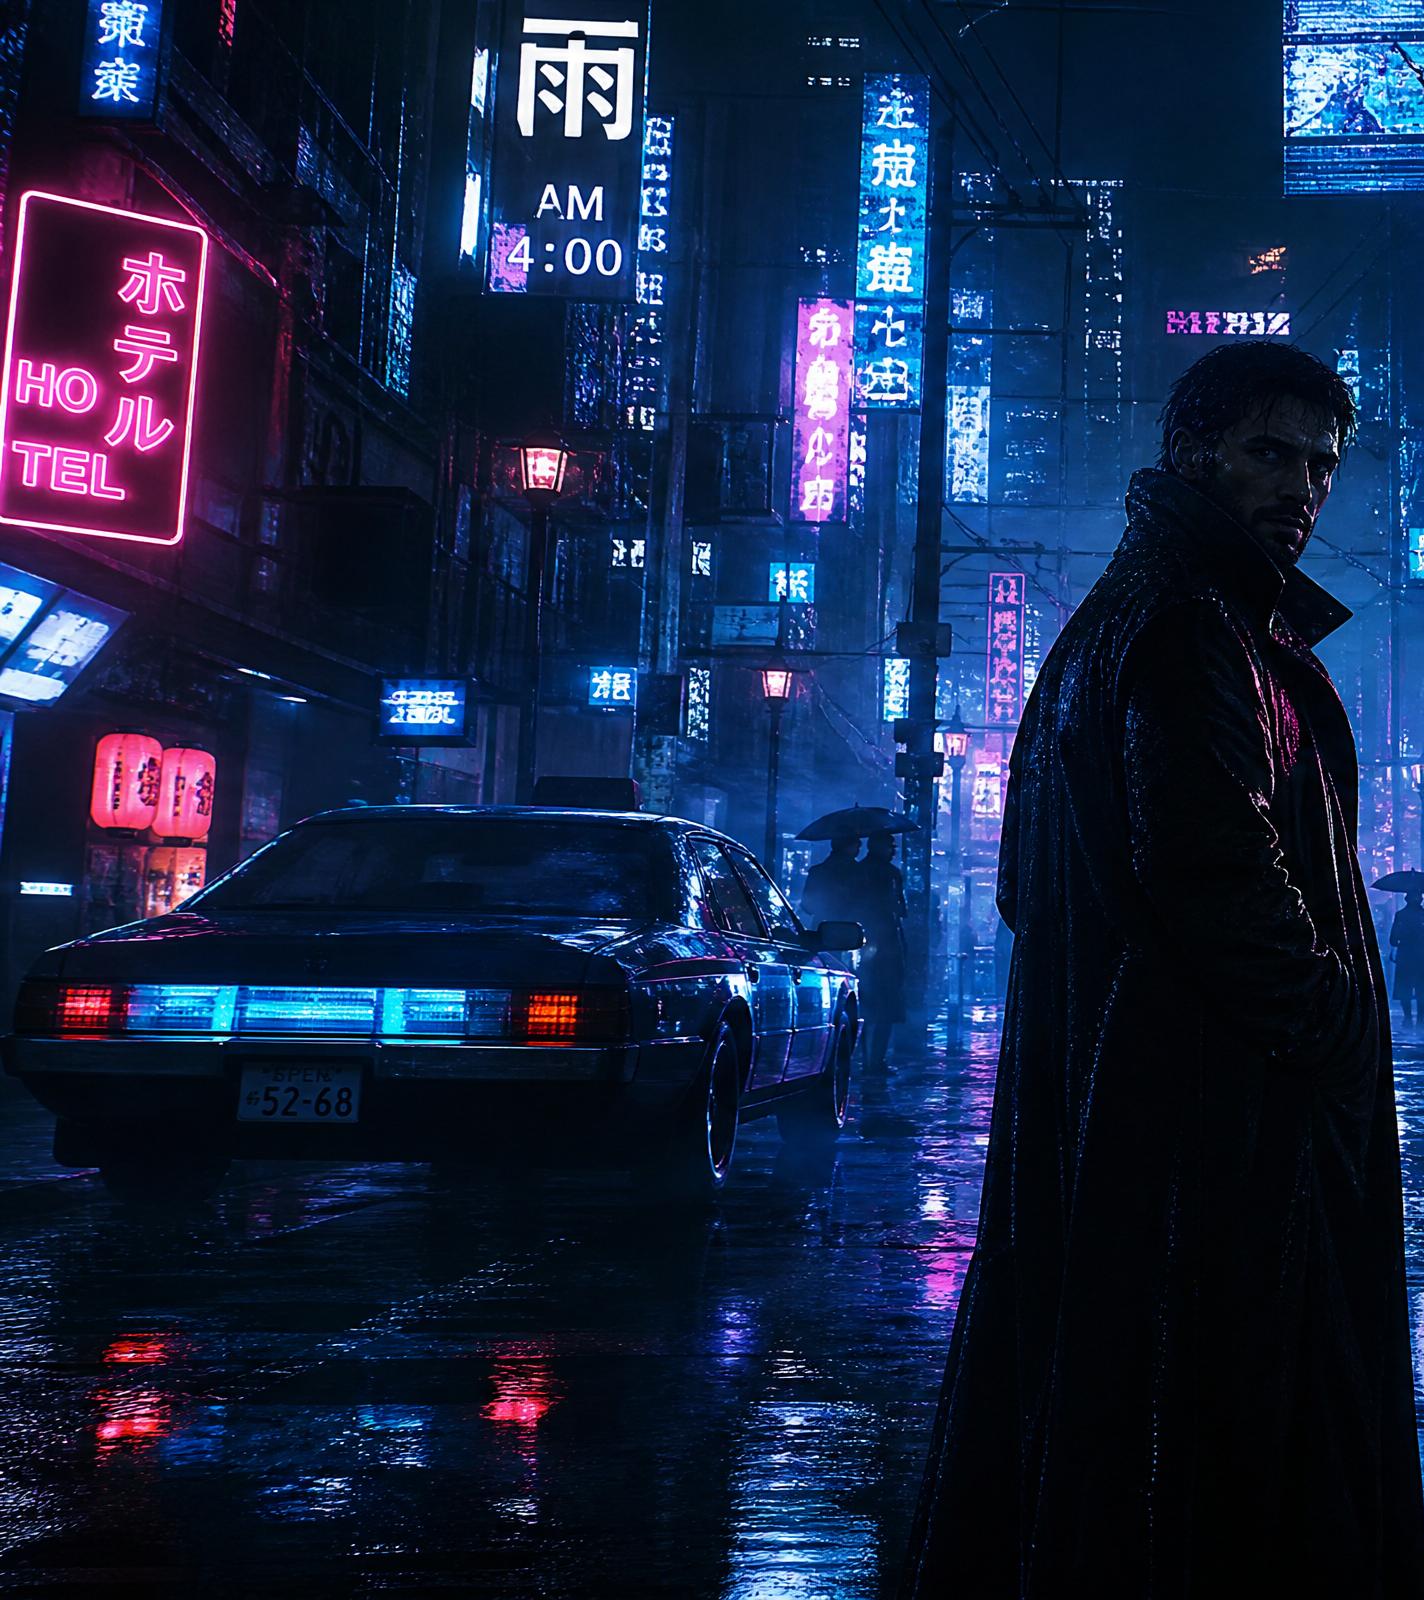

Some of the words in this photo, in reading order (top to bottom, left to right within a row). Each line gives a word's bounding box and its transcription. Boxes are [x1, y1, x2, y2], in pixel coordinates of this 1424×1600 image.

[517, 18, 639, 140] 雨
[536, 183, 604, 221] AM
[507, 235, 622, 276] 4:00
[104, 251, 186, 452] ホテル
[15, 359, 98, 414] HO
[12, 440, 125, 501] TEL
[261, 1086, 353, 1117] 52-68
